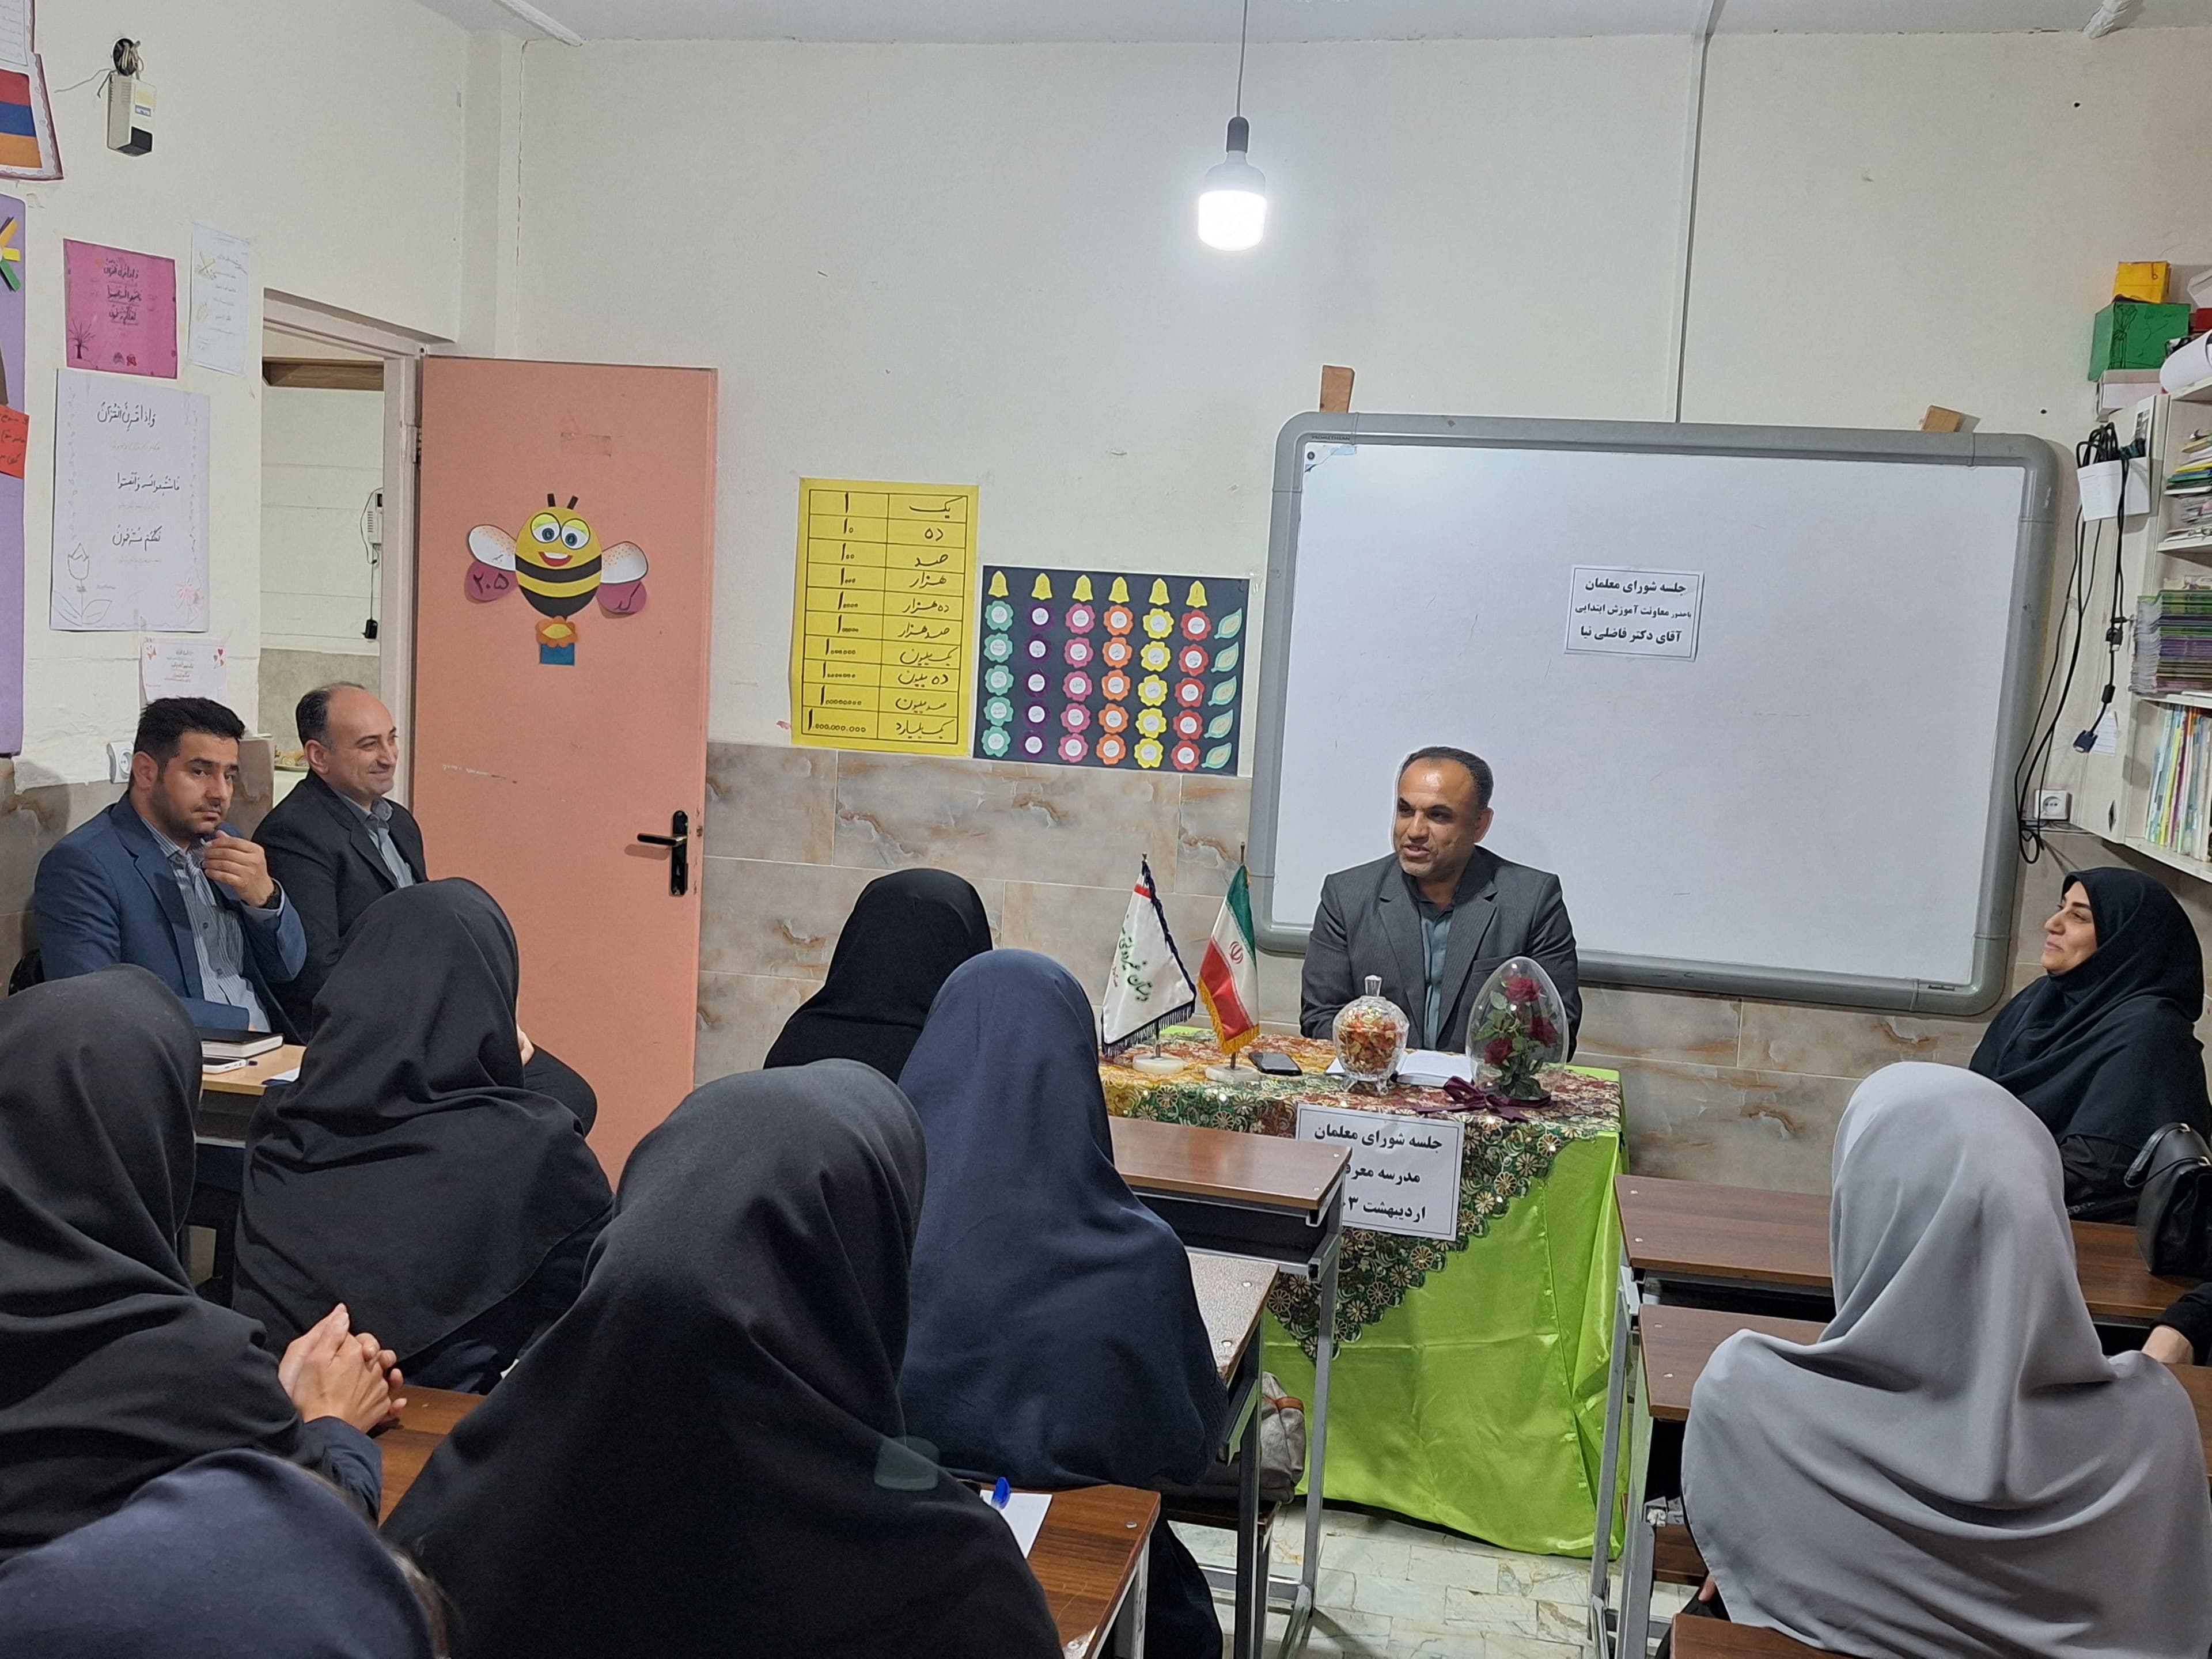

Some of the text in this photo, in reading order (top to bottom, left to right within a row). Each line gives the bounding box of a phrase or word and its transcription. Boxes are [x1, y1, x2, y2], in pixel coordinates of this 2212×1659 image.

[909, 496, 964, 519] یک
[925, 528, 944, 541] ده
[915, 554, 949, 567] صد
[909, 571, 947, 589] هزار
[1585, 577, 1687, 596] جلسه شورای معلمان
[1575, 602, 1605, 613] ابتدایی
[1607, 604, 1639, 616] آموزش
[1640, 607, 1669, 618] معاونت
[1580, 625, 1683, 644] آقای دکتر فاضلی نیا
[931, 673, 949, 685] ده
[1314, 1123, 1442, 1154] جلسه شورای معلمان
[1378, 1169, 1421, 1185] مدرسه
[1363, 1201, 1426, 1223] اردیبهشت
